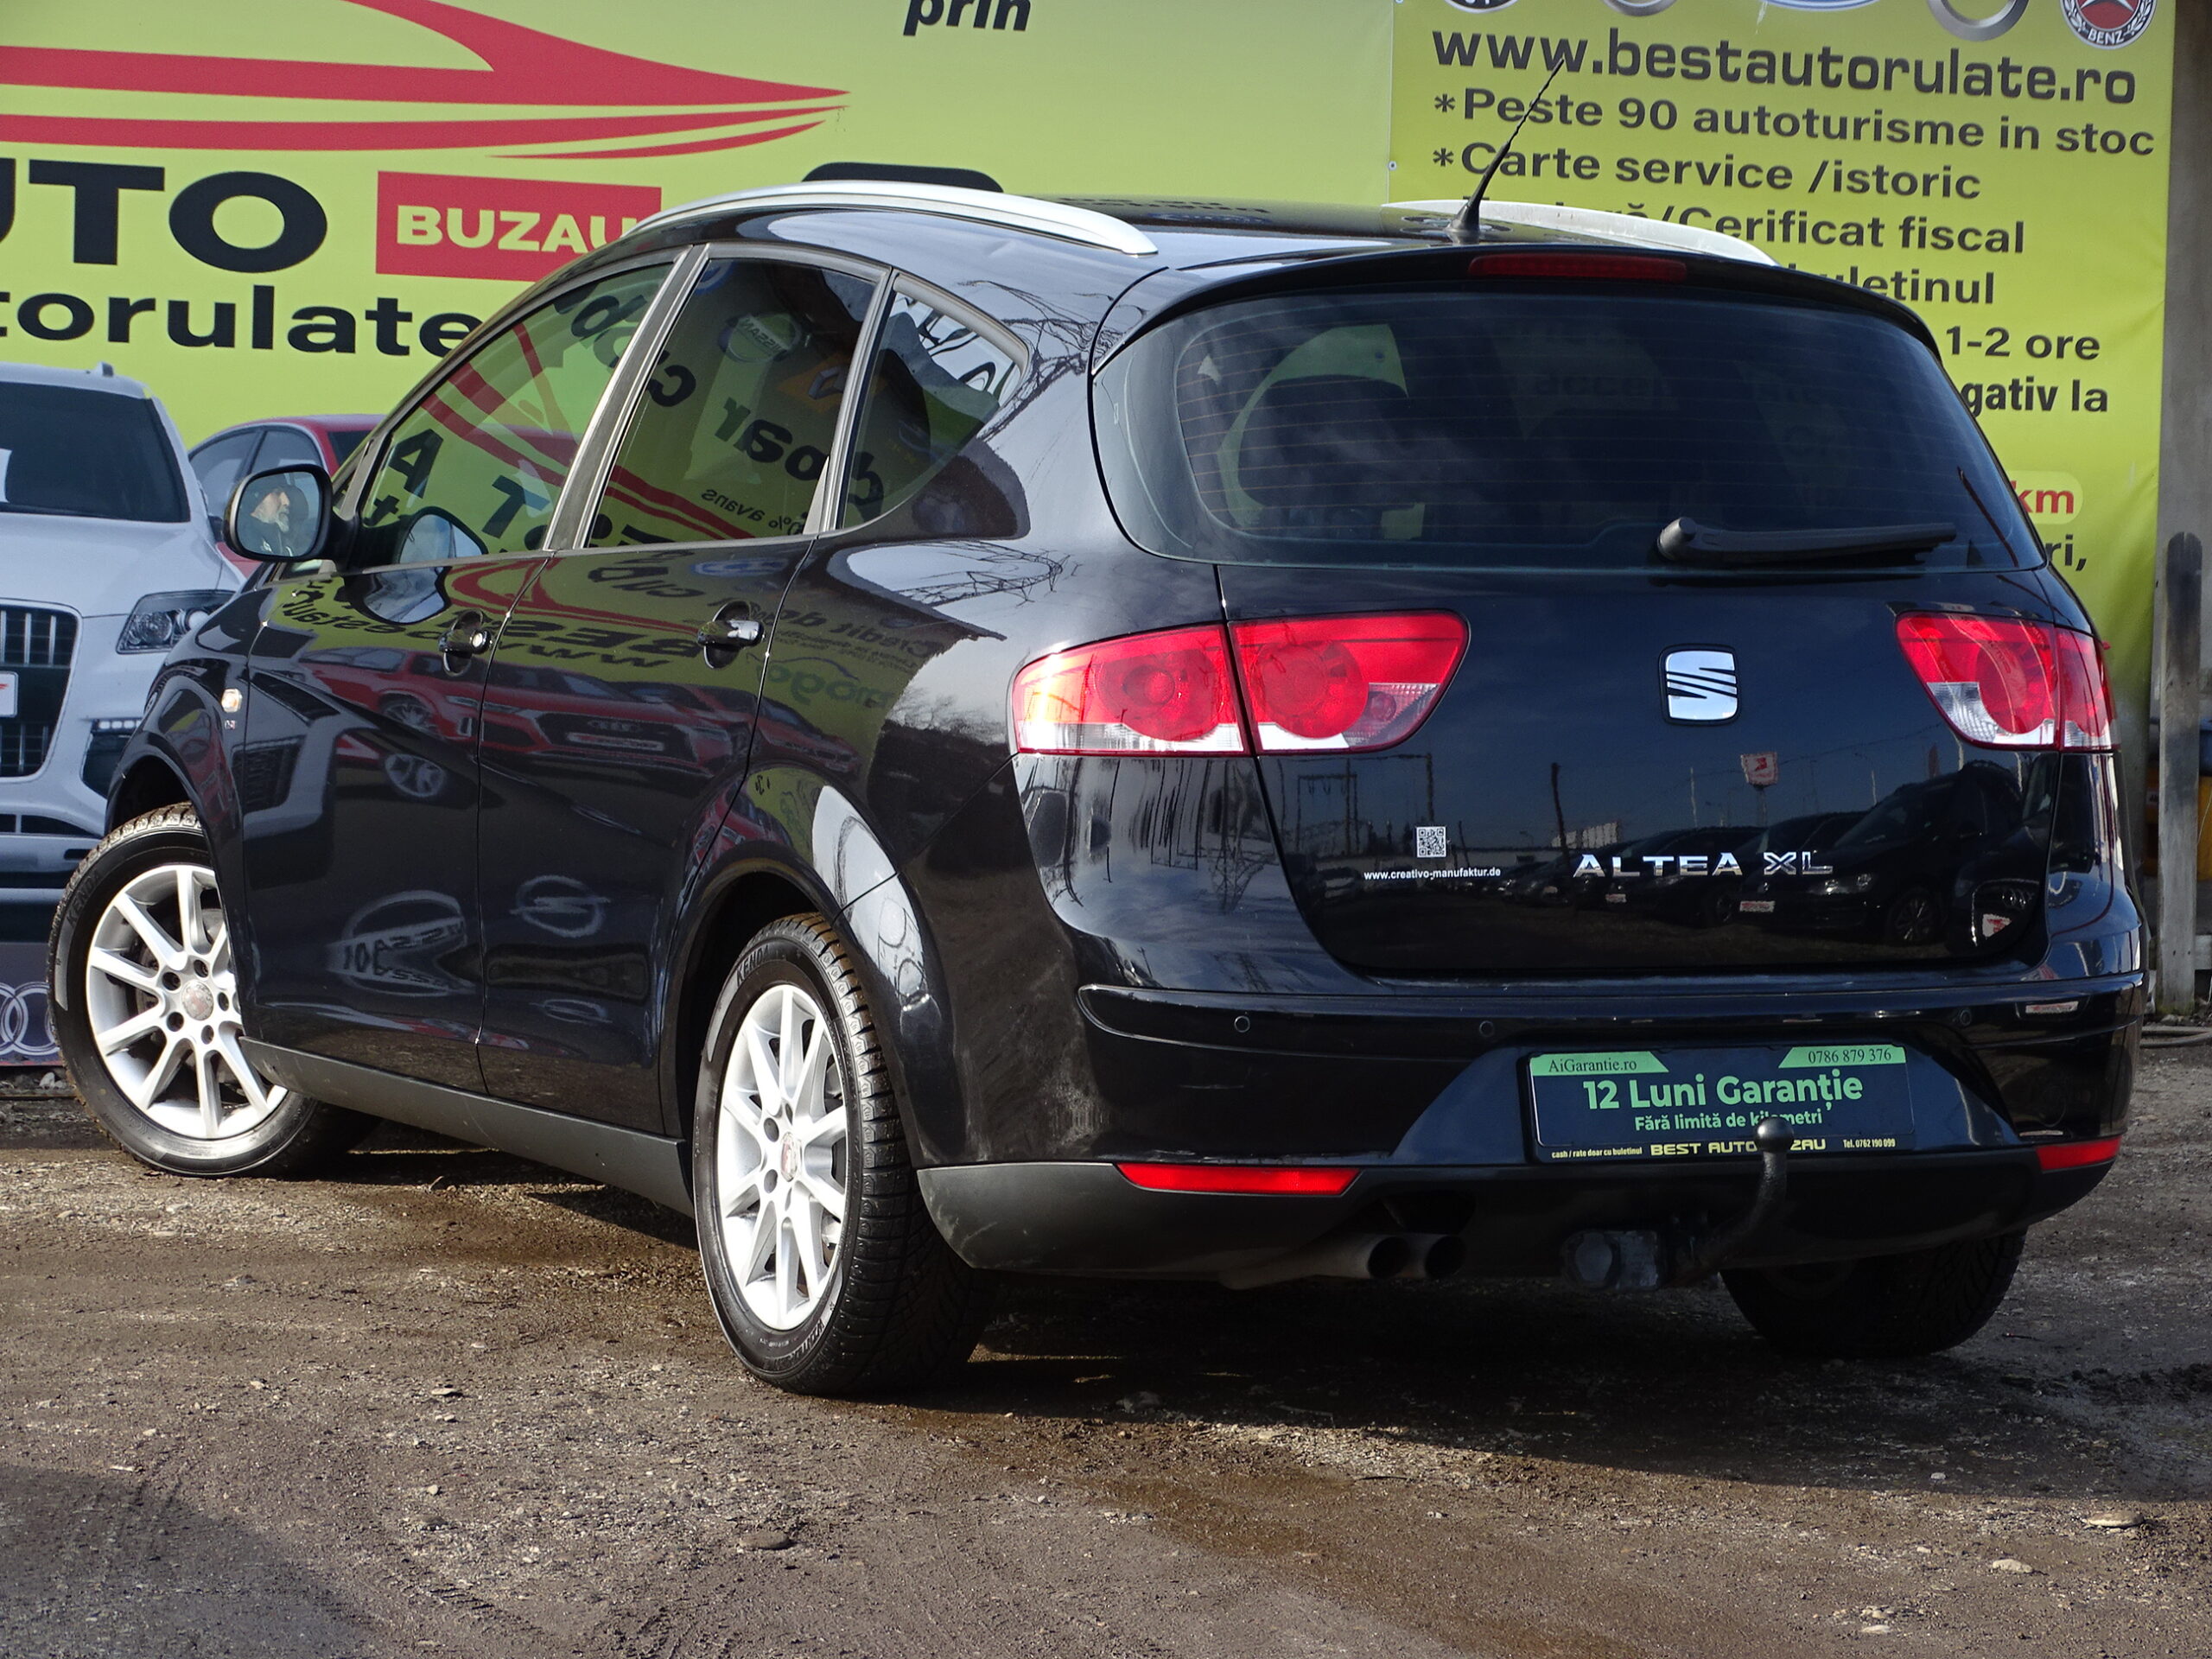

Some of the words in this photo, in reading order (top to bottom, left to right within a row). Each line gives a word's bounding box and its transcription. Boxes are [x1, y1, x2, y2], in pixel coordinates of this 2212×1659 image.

[903, 0, 1031, 36] prin
[2088, 28, 2124, 45] BENZ
[1433, 28, 2135, 104] www.bestautorulate.ro
[1618, 98, 1677, 130] 90
[1694, 105, 1984, 147] autoturisme
[1999, 116, 2039, 150] in
[2056, 123, 2154, 156] stoc
[1616, 154, 1793, 190] service
[1808, 160, 1980, 199] /istoric
[0, 157, 327, 273] TO
[1899, 215, 2024, 253] fiscal
[1946, 326, 2011, 357] 1-2
[2025, 334, 2101, 360] ore
[1960, 376, 2058, 417] gativ
[2072, 379, 2108, 412] la
[1573, 853, 1744, 879] ALTEA
[1763, 851, 1834, 875] XL
[1548, 1058, 1637, 1073] AiGarantie.ro
[1808, 1049, 1840, 1064] 0786
[1842, 1049, 1866, 1063] 879
[1870, 1048, 1891, 1062] 376
[1583, 1079, 1619, 1109] 12
[1630, 1074, 1707, 1109] Luni
[1635, 1114, 1670, 1131] Fără
[1675, 1111, 1719, 1129] limită
[1726, 1112, 1745, 1128] de
[1573, 1149, 1586, 1158] rate
[1587, 1148, 1602, 1157] doar
[1649, 1142, 1700, 1156] BEST
[1708, 1141, 1758, 1154] AUTO
[1789, 1139, 1827, 1151] ZAU
